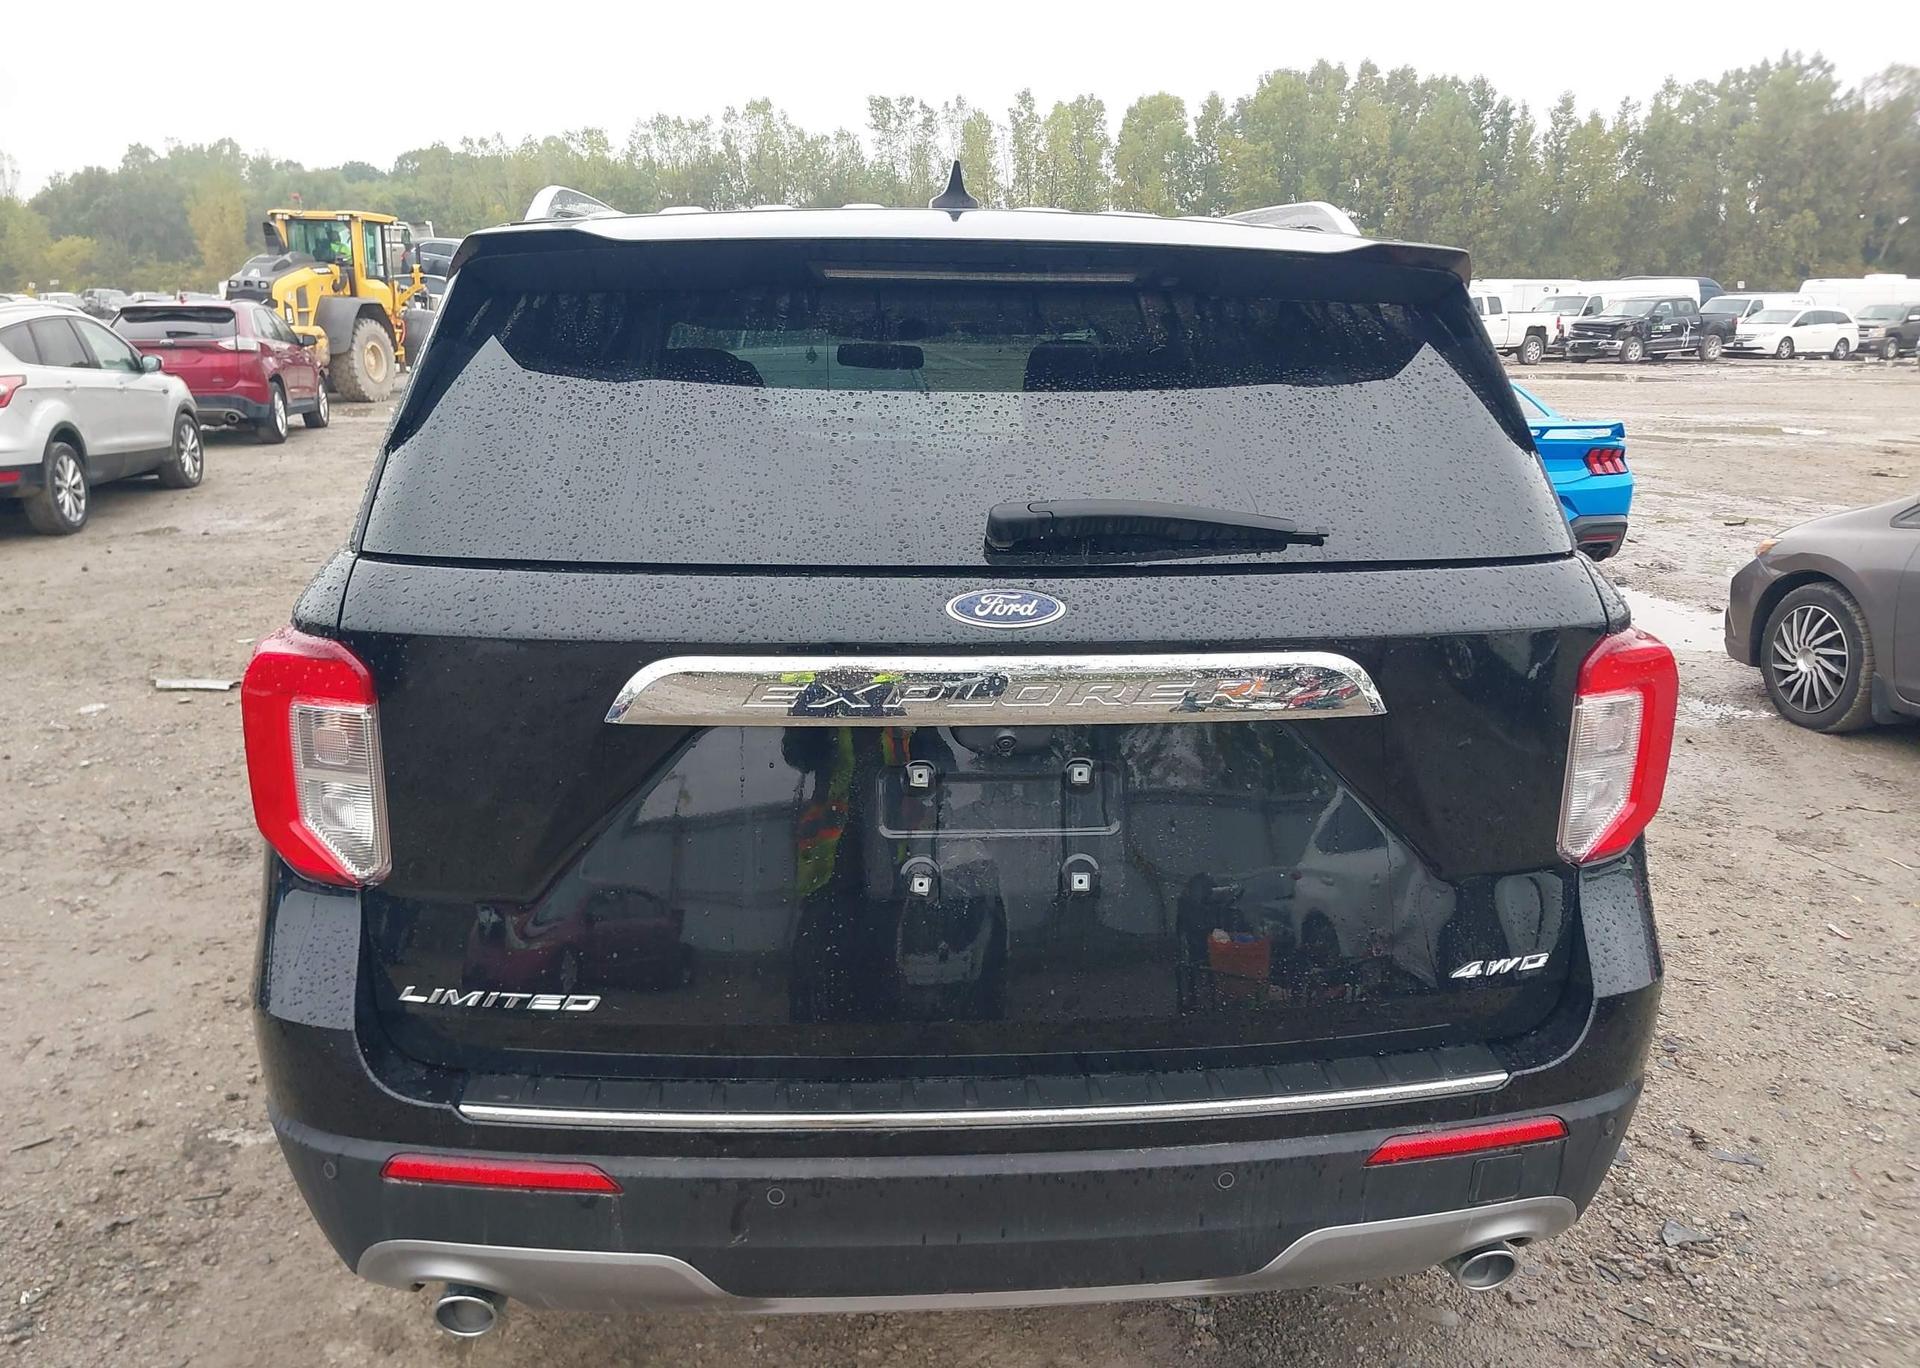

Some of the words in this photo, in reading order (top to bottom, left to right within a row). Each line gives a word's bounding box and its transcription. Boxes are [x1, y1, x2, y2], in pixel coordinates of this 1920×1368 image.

[974, 594, 1038, 616] Ford
[743, 678, 1258, 708] EXPLORER
[1449, 952, 1550, 979] 4WD
[398, 985, 602, 1012] LIMITED
